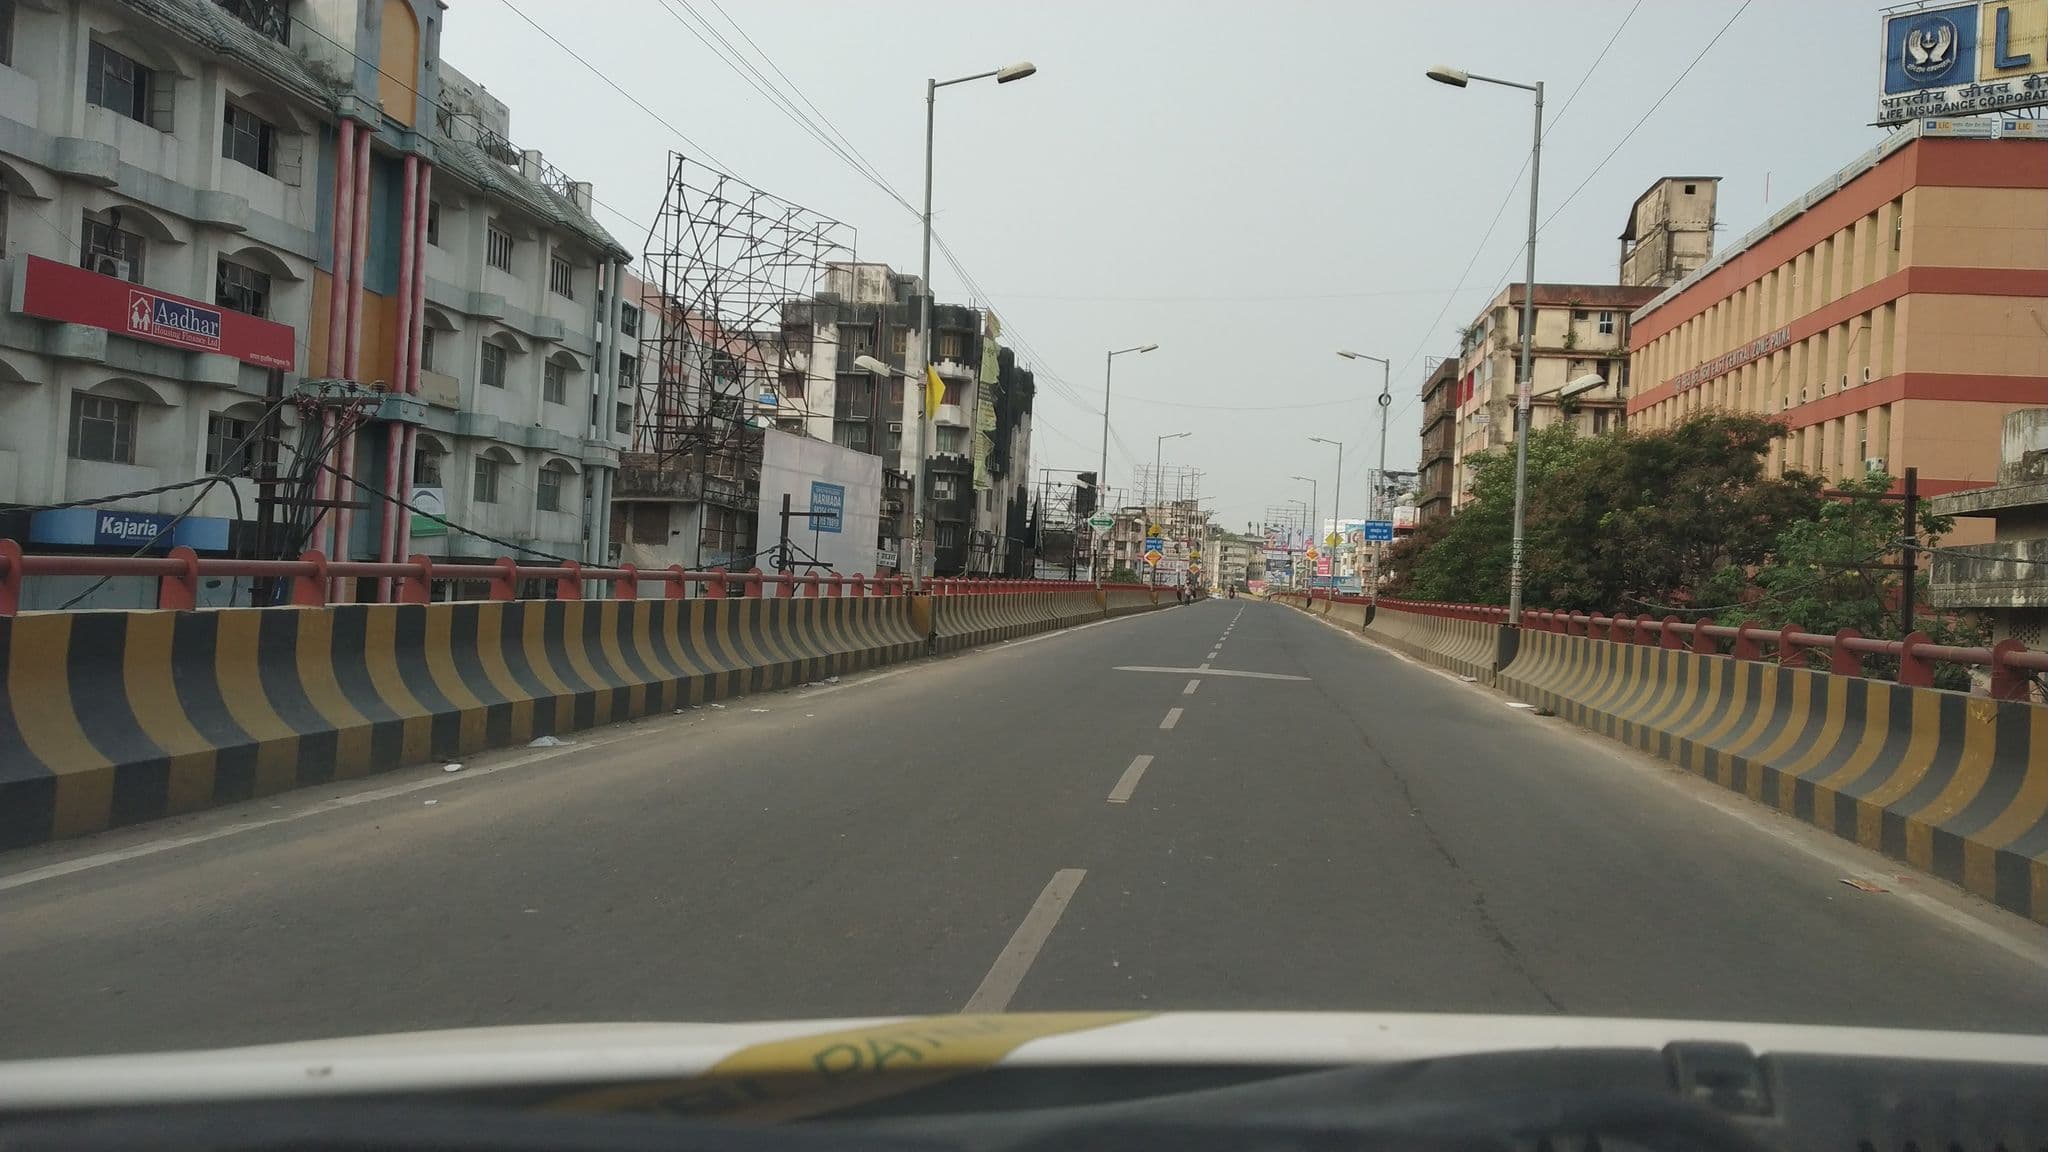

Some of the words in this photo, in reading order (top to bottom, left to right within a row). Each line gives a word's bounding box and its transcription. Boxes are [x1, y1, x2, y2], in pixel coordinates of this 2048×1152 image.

[1881, 90, 1946, 109] भारतीय
[1958, 83, 2010, 99] जीवन
[1880, 108, 1904, 120] LIFE
[1906, 98, 1976, 117] INSURANCE
[155, 302, 218, 336] Aadhar
[154, 324, 182, 340] Housing
[182, 331, 207, 345] Finance
[207, 337, 218, 347] Ltd
[101, 516, 158, 539] Kajaria
